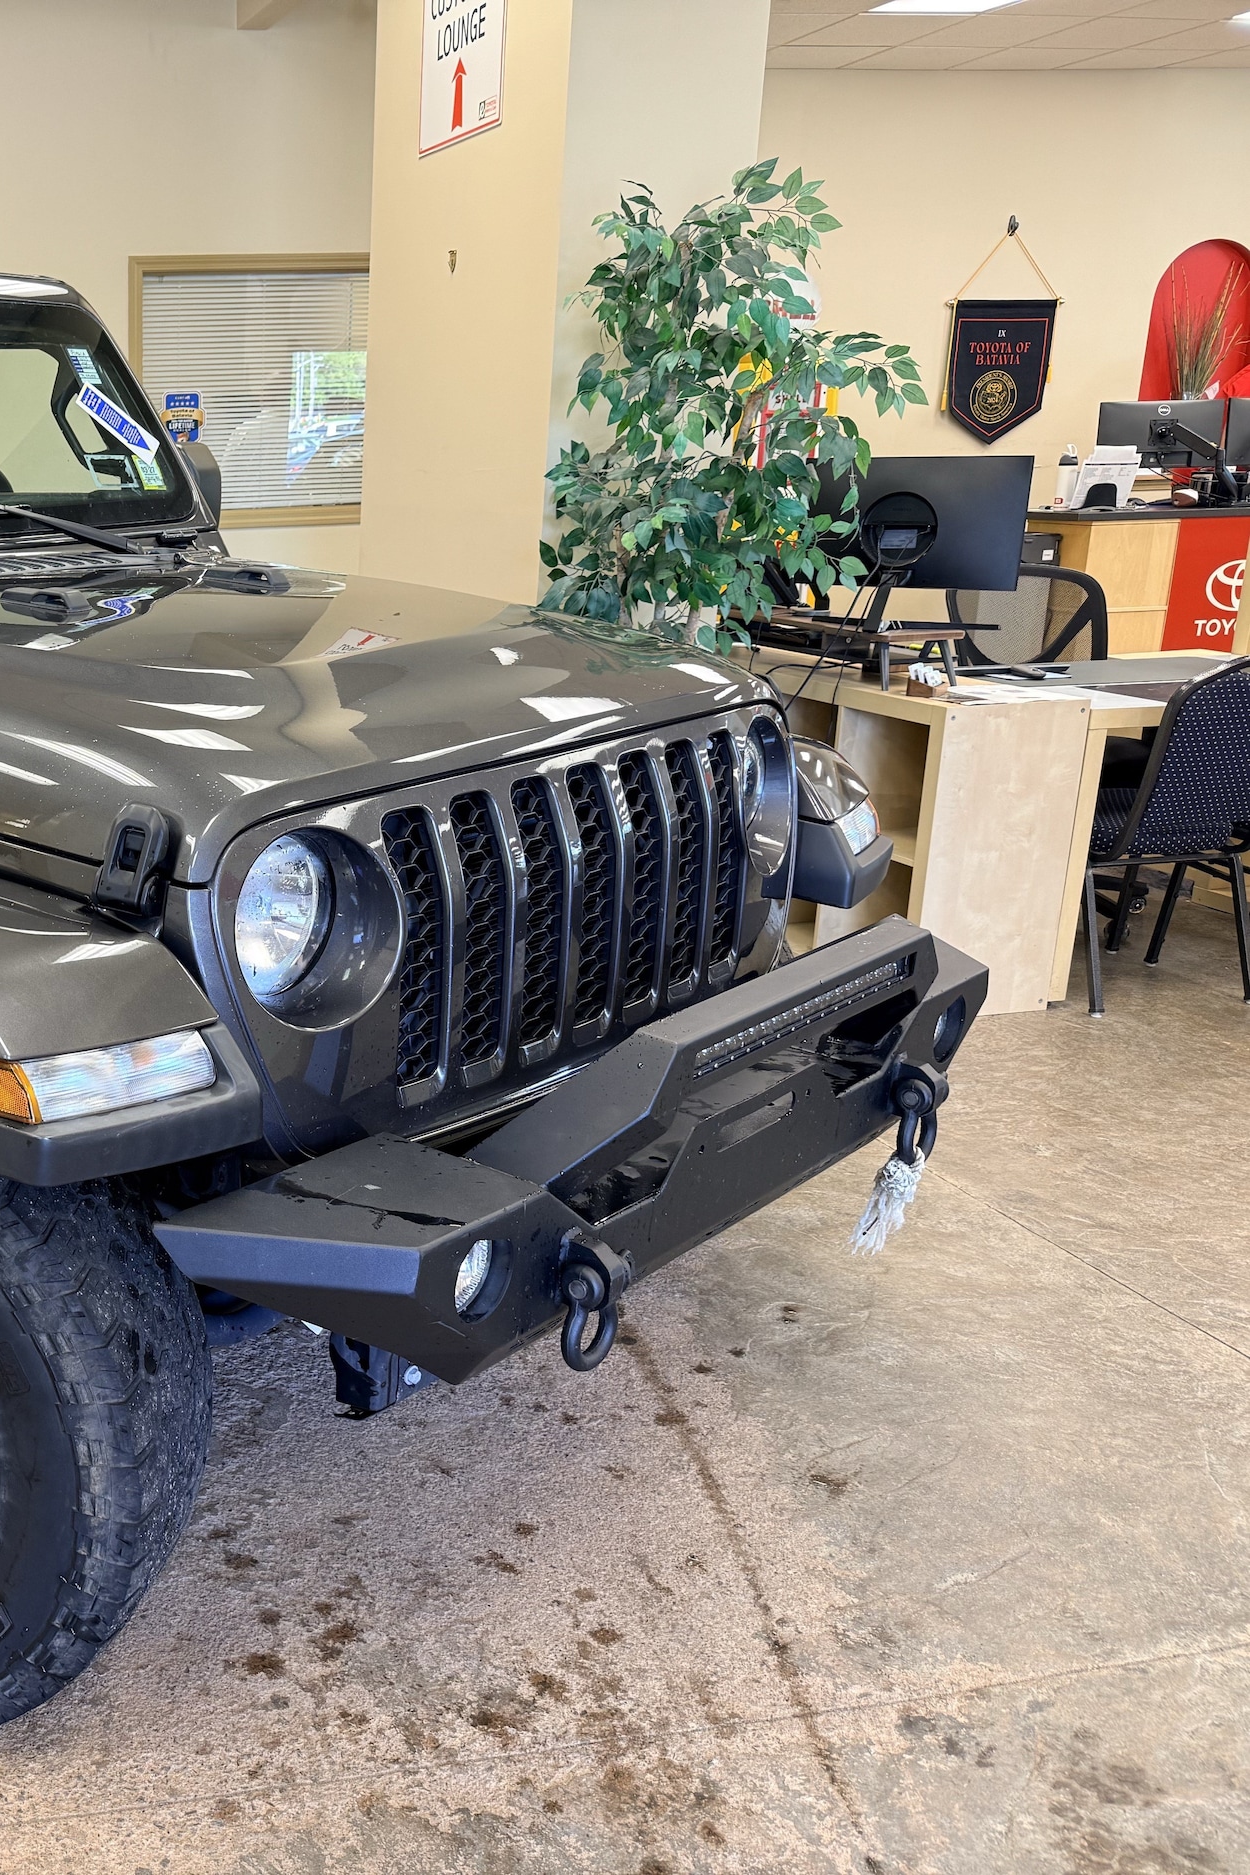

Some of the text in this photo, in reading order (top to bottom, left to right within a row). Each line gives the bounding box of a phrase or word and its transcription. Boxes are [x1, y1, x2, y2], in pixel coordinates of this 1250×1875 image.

[436, 3, 487, 61] LOUNGE
[997, 329, 1007, 338] IX
[969, 341, 1032, 354] TOYOTA OF
[975, 354, 1021, 366] BATAVIA
[1194, 618, 1237, 637] TOY
